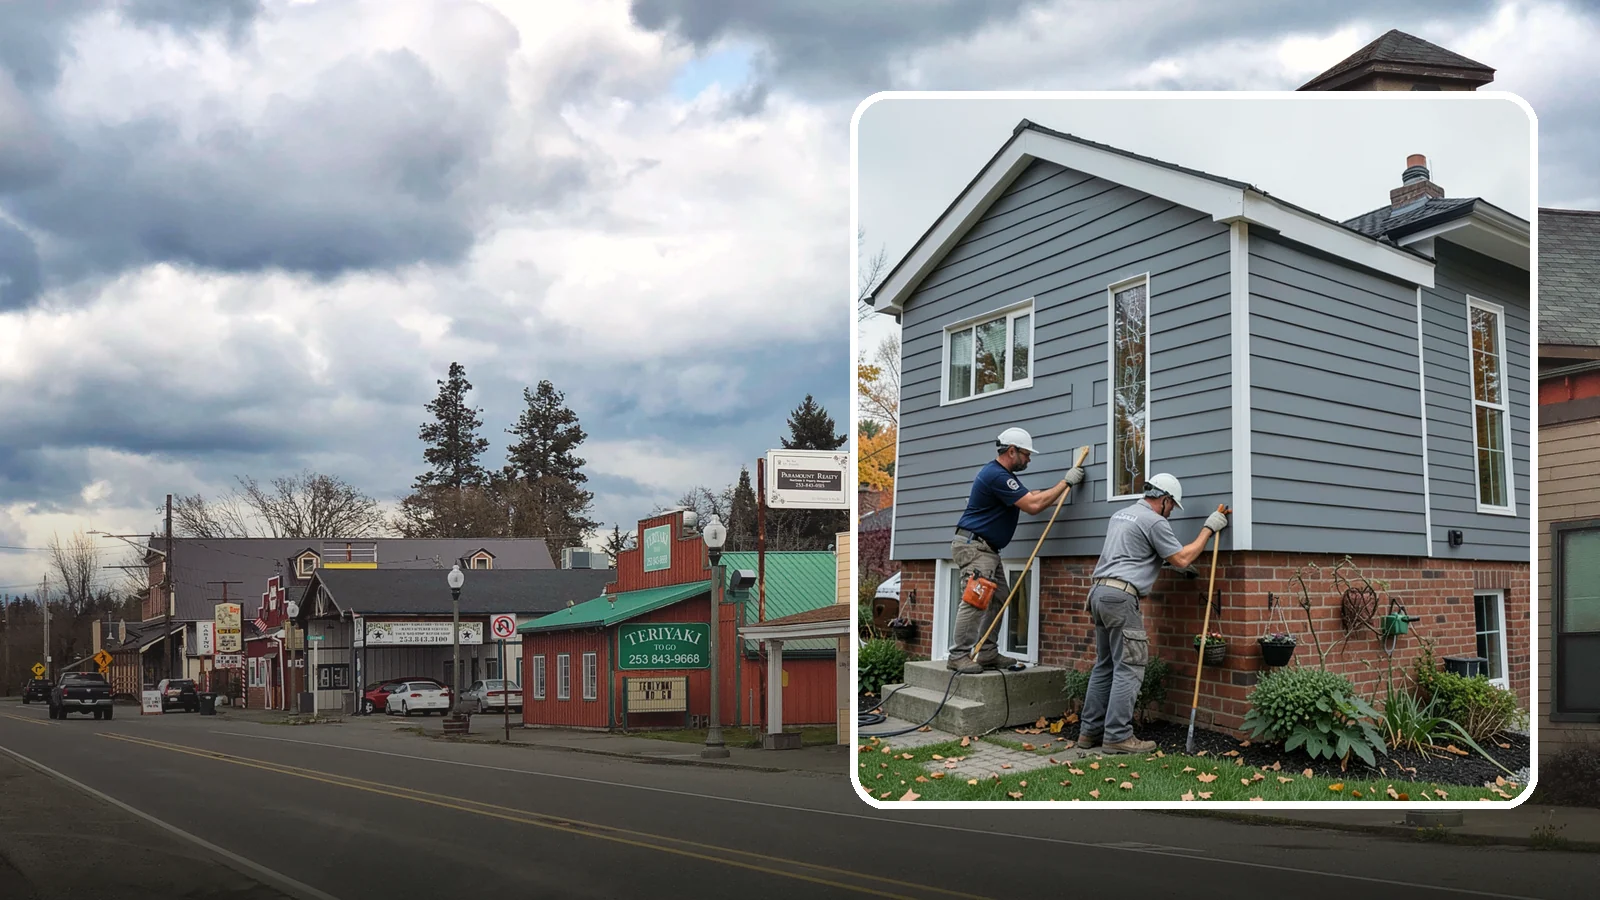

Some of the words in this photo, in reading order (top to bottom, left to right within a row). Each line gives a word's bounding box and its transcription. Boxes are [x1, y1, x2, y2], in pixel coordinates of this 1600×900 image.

[781, 471, 815, 479] PARAMOUNT
[817, 472, 839, 480] REALTY
[624, 627, 702, 646] TERIYAKI
[628, 654, 648, 664] 253
[651, 654, 700, 664] 843-9668
